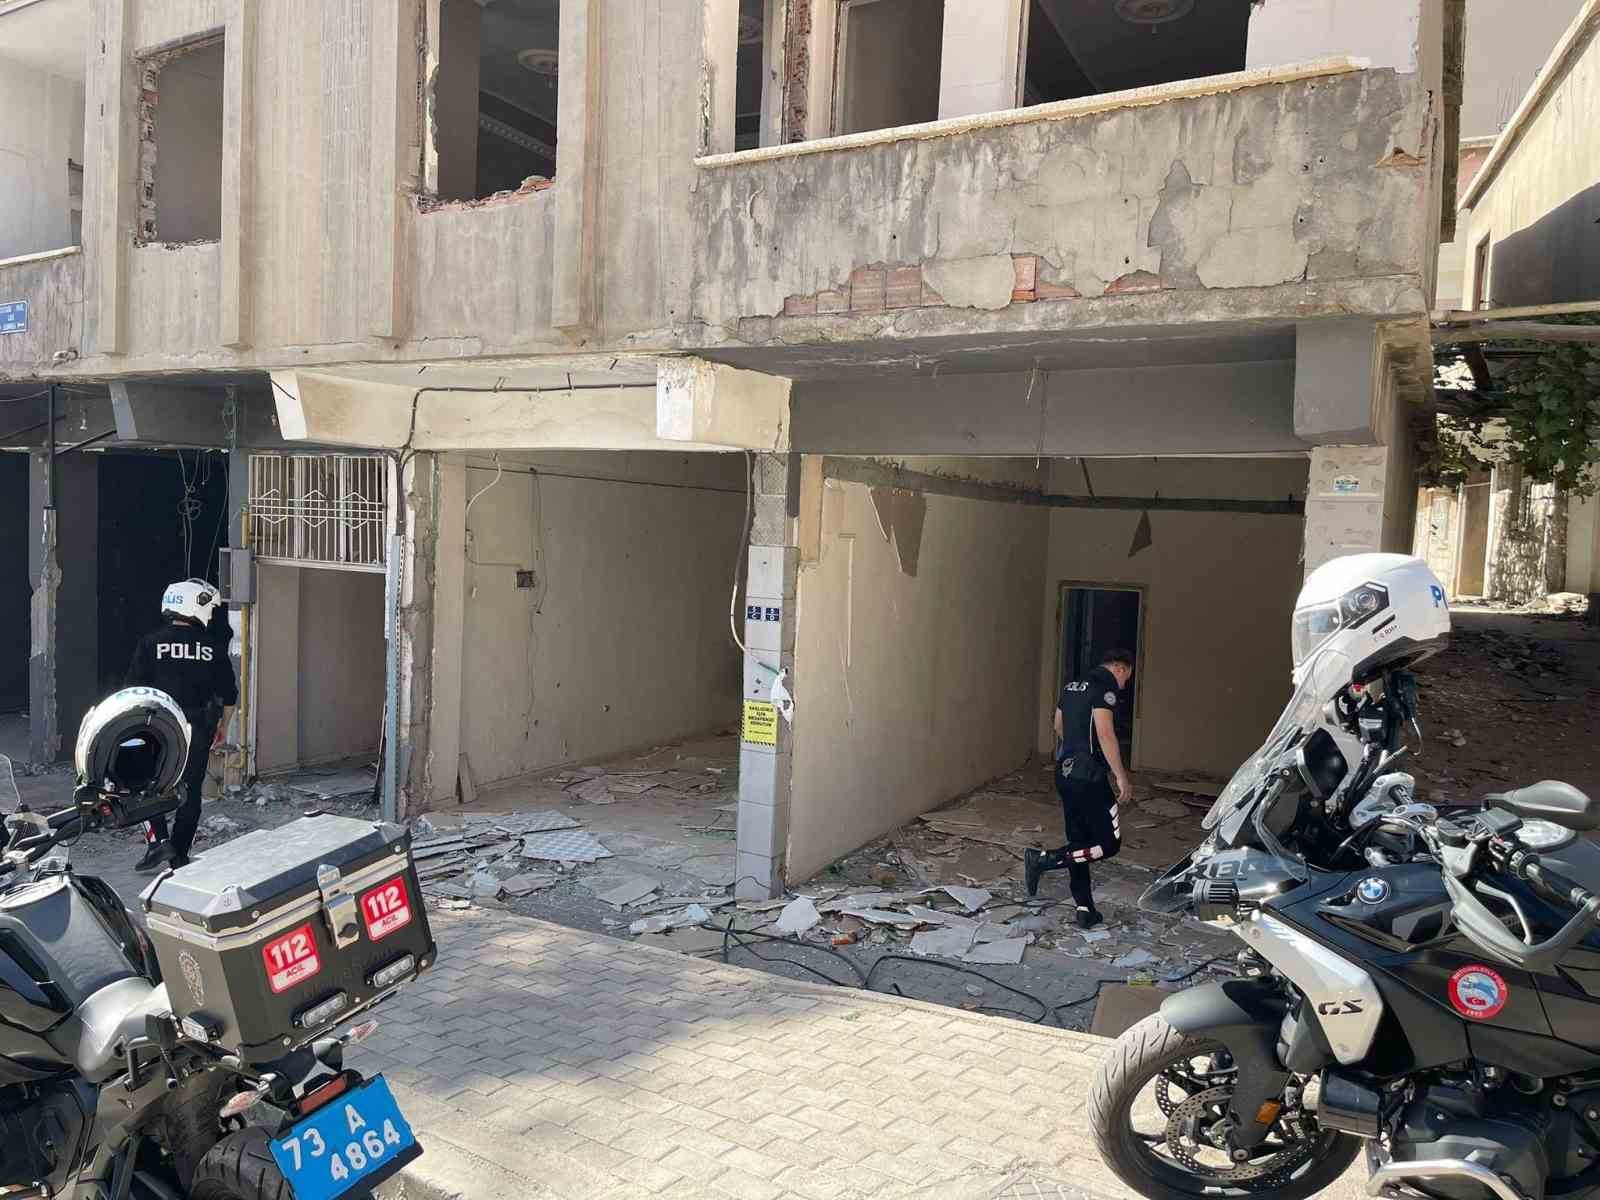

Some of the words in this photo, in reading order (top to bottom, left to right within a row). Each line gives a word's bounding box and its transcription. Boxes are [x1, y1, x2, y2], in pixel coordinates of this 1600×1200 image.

[156, 641, 213, 661] POLİS
[367, 886, 402, 919] 112
[271, 934, 310, 969] 112
[1318, 999, 1362, 1015] GS
[282, 1127, 325, 1170] 73
[345, 1104, 366, 1134] A
[330, 1118, 401, 1181] 4864
